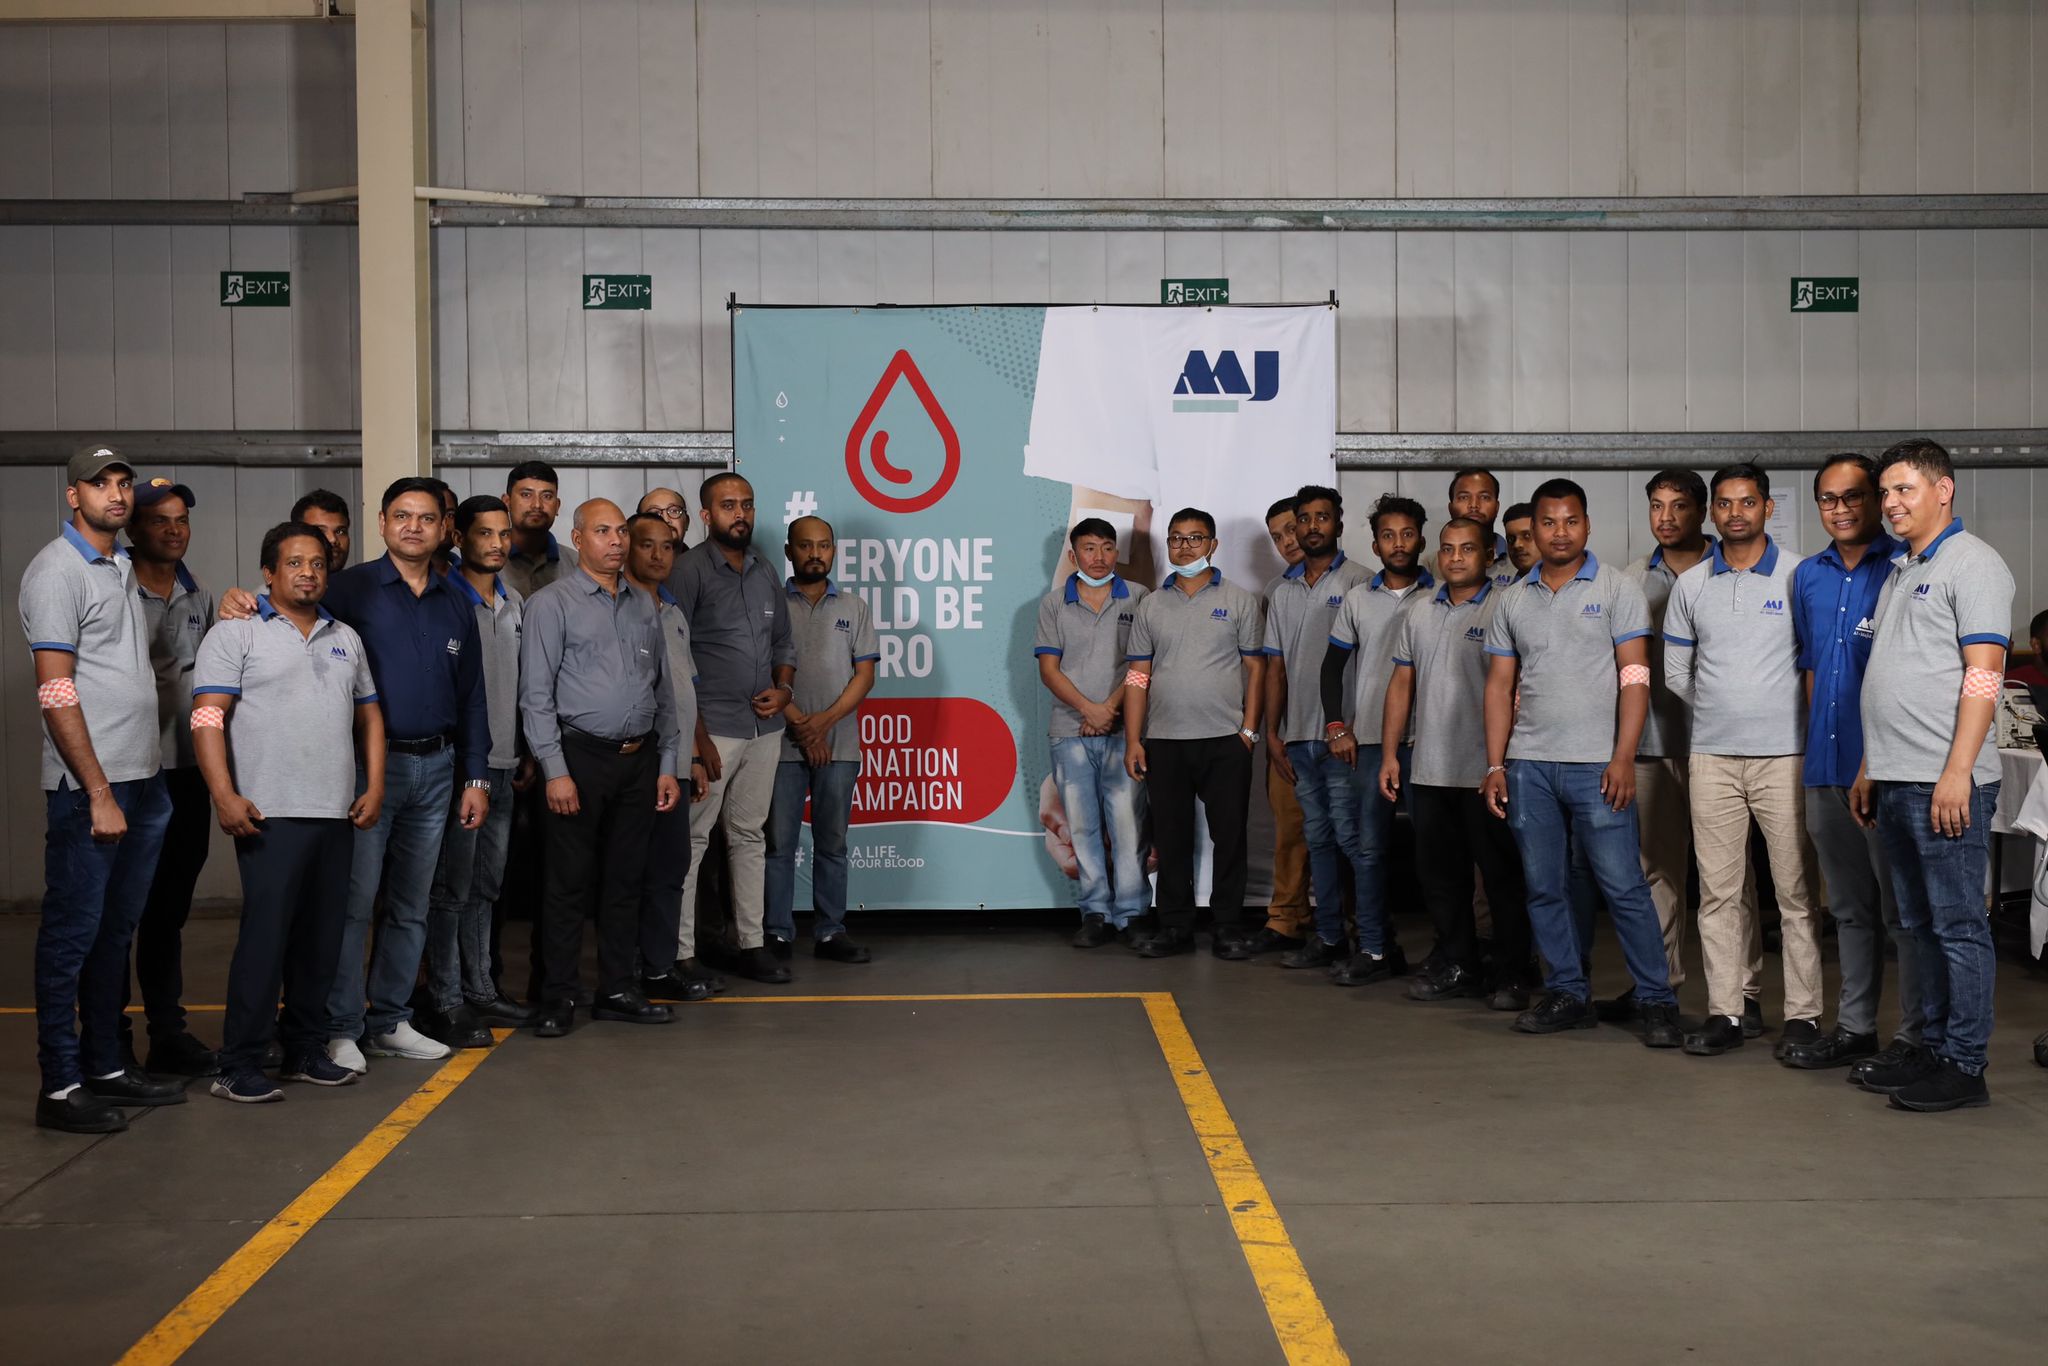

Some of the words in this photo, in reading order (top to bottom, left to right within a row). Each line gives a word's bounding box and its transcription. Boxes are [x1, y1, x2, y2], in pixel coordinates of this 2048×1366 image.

[245, 281, 281, 294] EXIT
[608, 284, 643, 297] EXIT
[1185, 288, 1220, 301] EXIT
[1815, 286, 1850, 300] EXIT
[785, 538, 993, 582] ERYONE
[935, 586, 983, 630] BE
[879, 634, 933, 679] RO
[861, 714, 912, 744] OOD
[857, 747, 958, 777] NATION
[851, 781, 963, 811] AMPAIGN
[849, 859, 882, 868] YOUR
[885, 858, 925, 868] BLOOD
[851, 846, 862, 858] A
[866, 845, 900, 860] LIFE,
